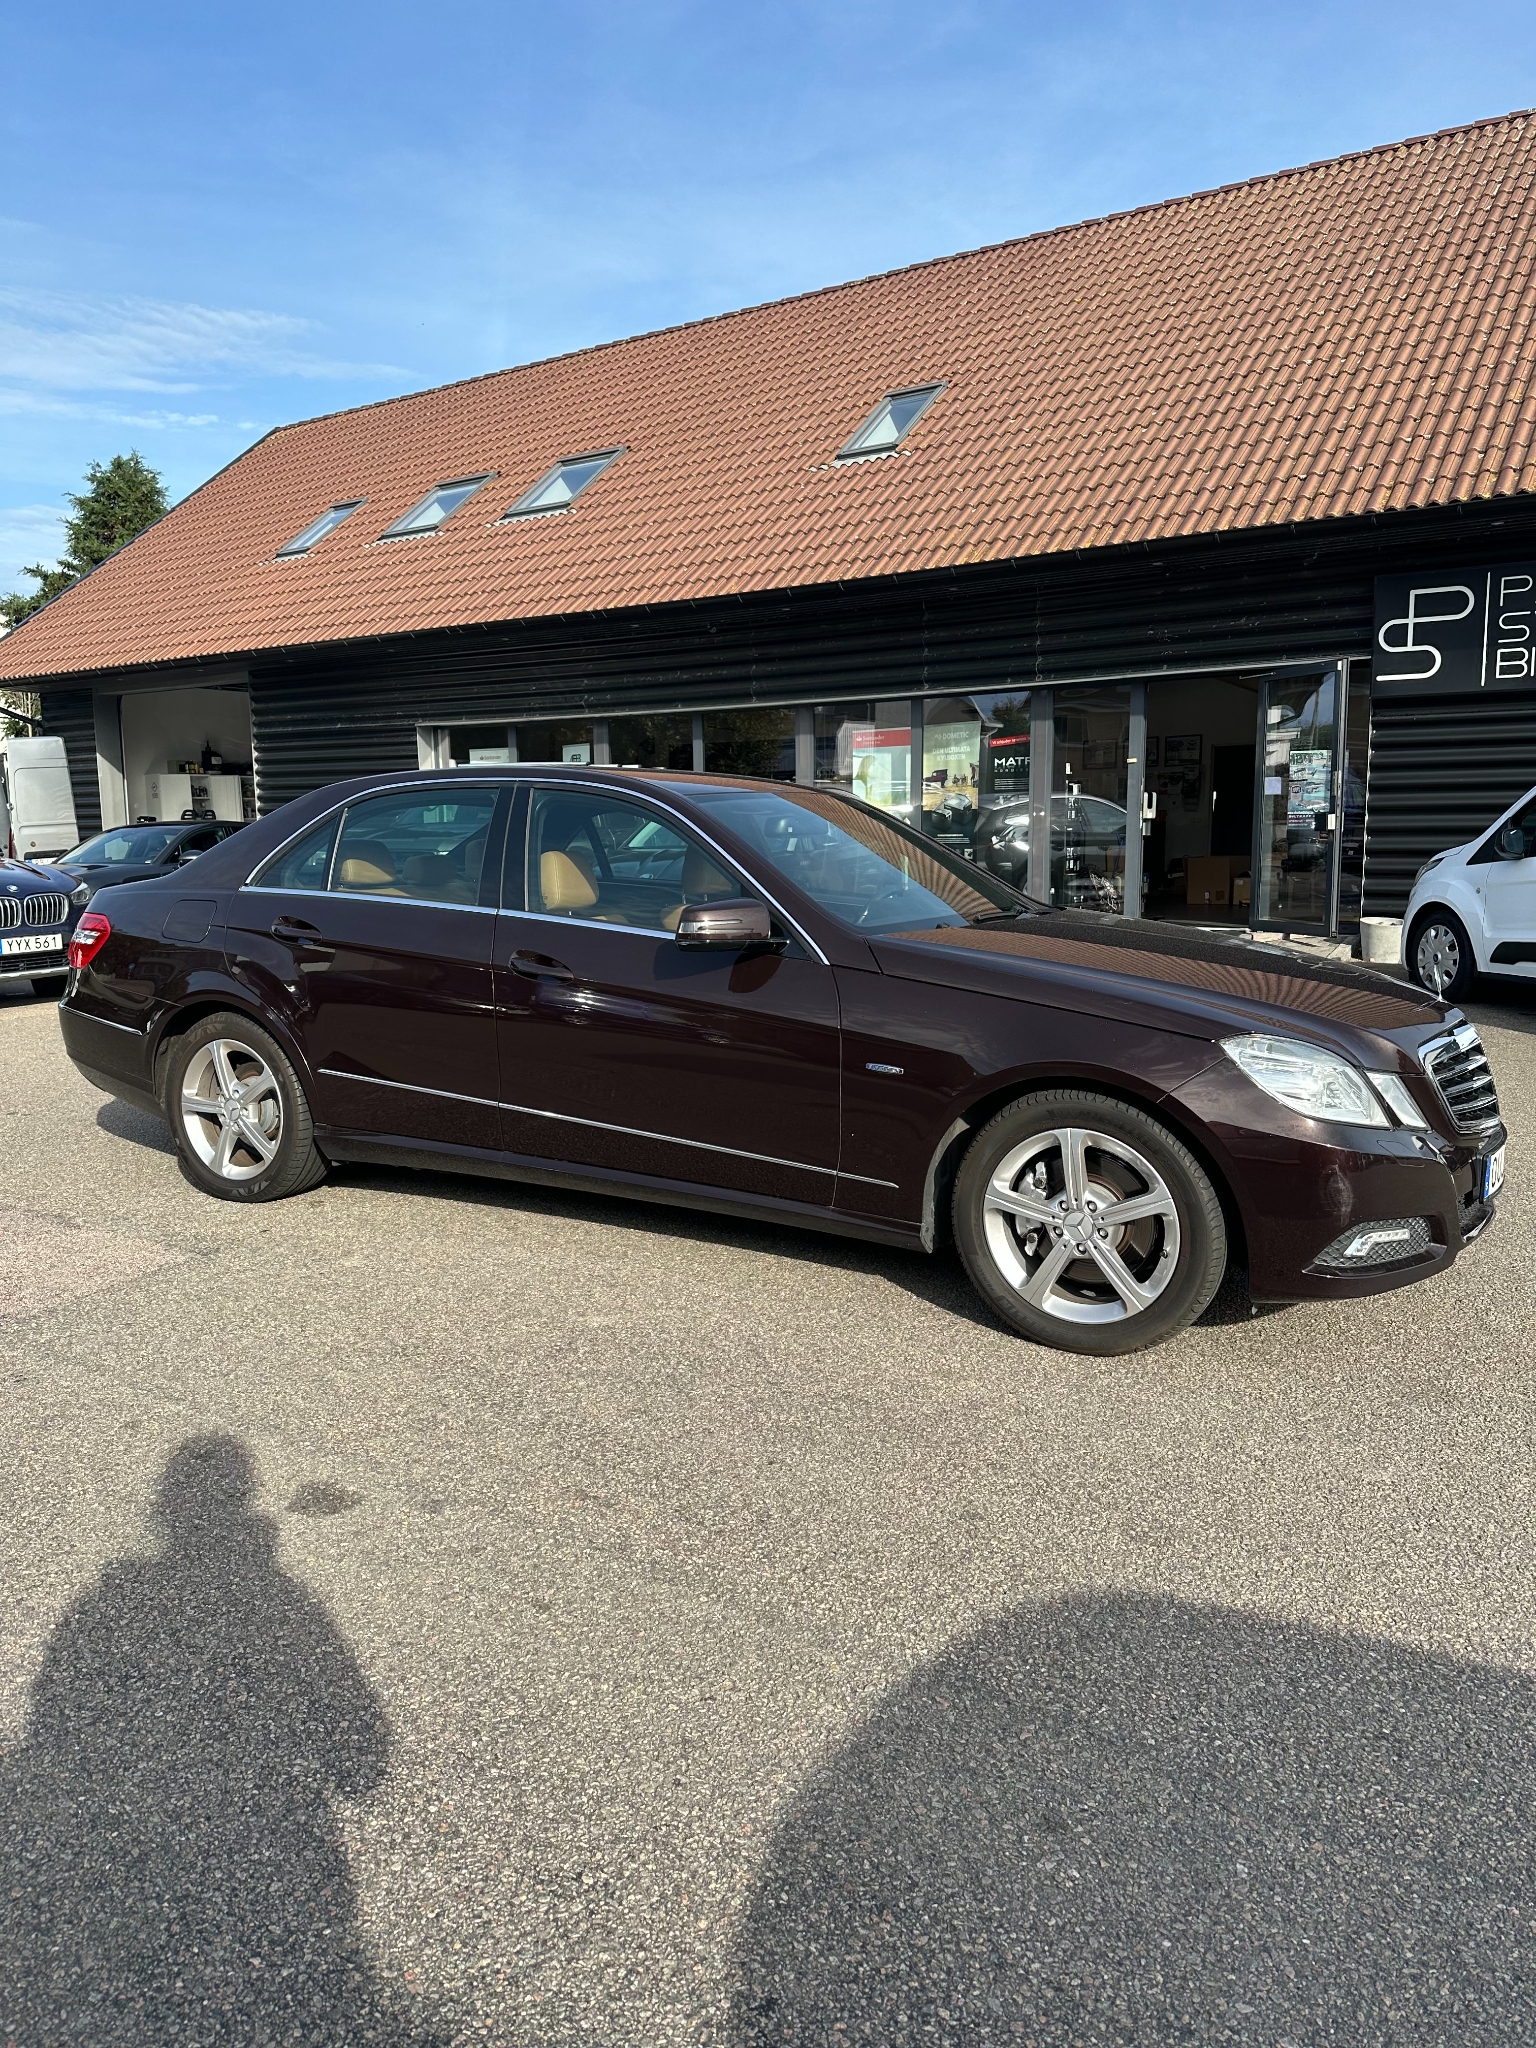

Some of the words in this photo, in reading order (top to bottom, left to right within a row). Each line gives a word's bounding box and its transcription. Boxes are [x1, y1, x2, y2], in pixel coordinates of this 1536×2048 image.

[1498, 611, 1536, 643] S
[942, 731, 970, 740] DOMETIC
[932, 747, 944, 755] DEN
[944, 745, 971, 754] ULTIMATA
[936, 753, 966, 762] KYLBOXEN
[6, 938, 31, 952] YYX
[34, 936, 57, 950] 561
